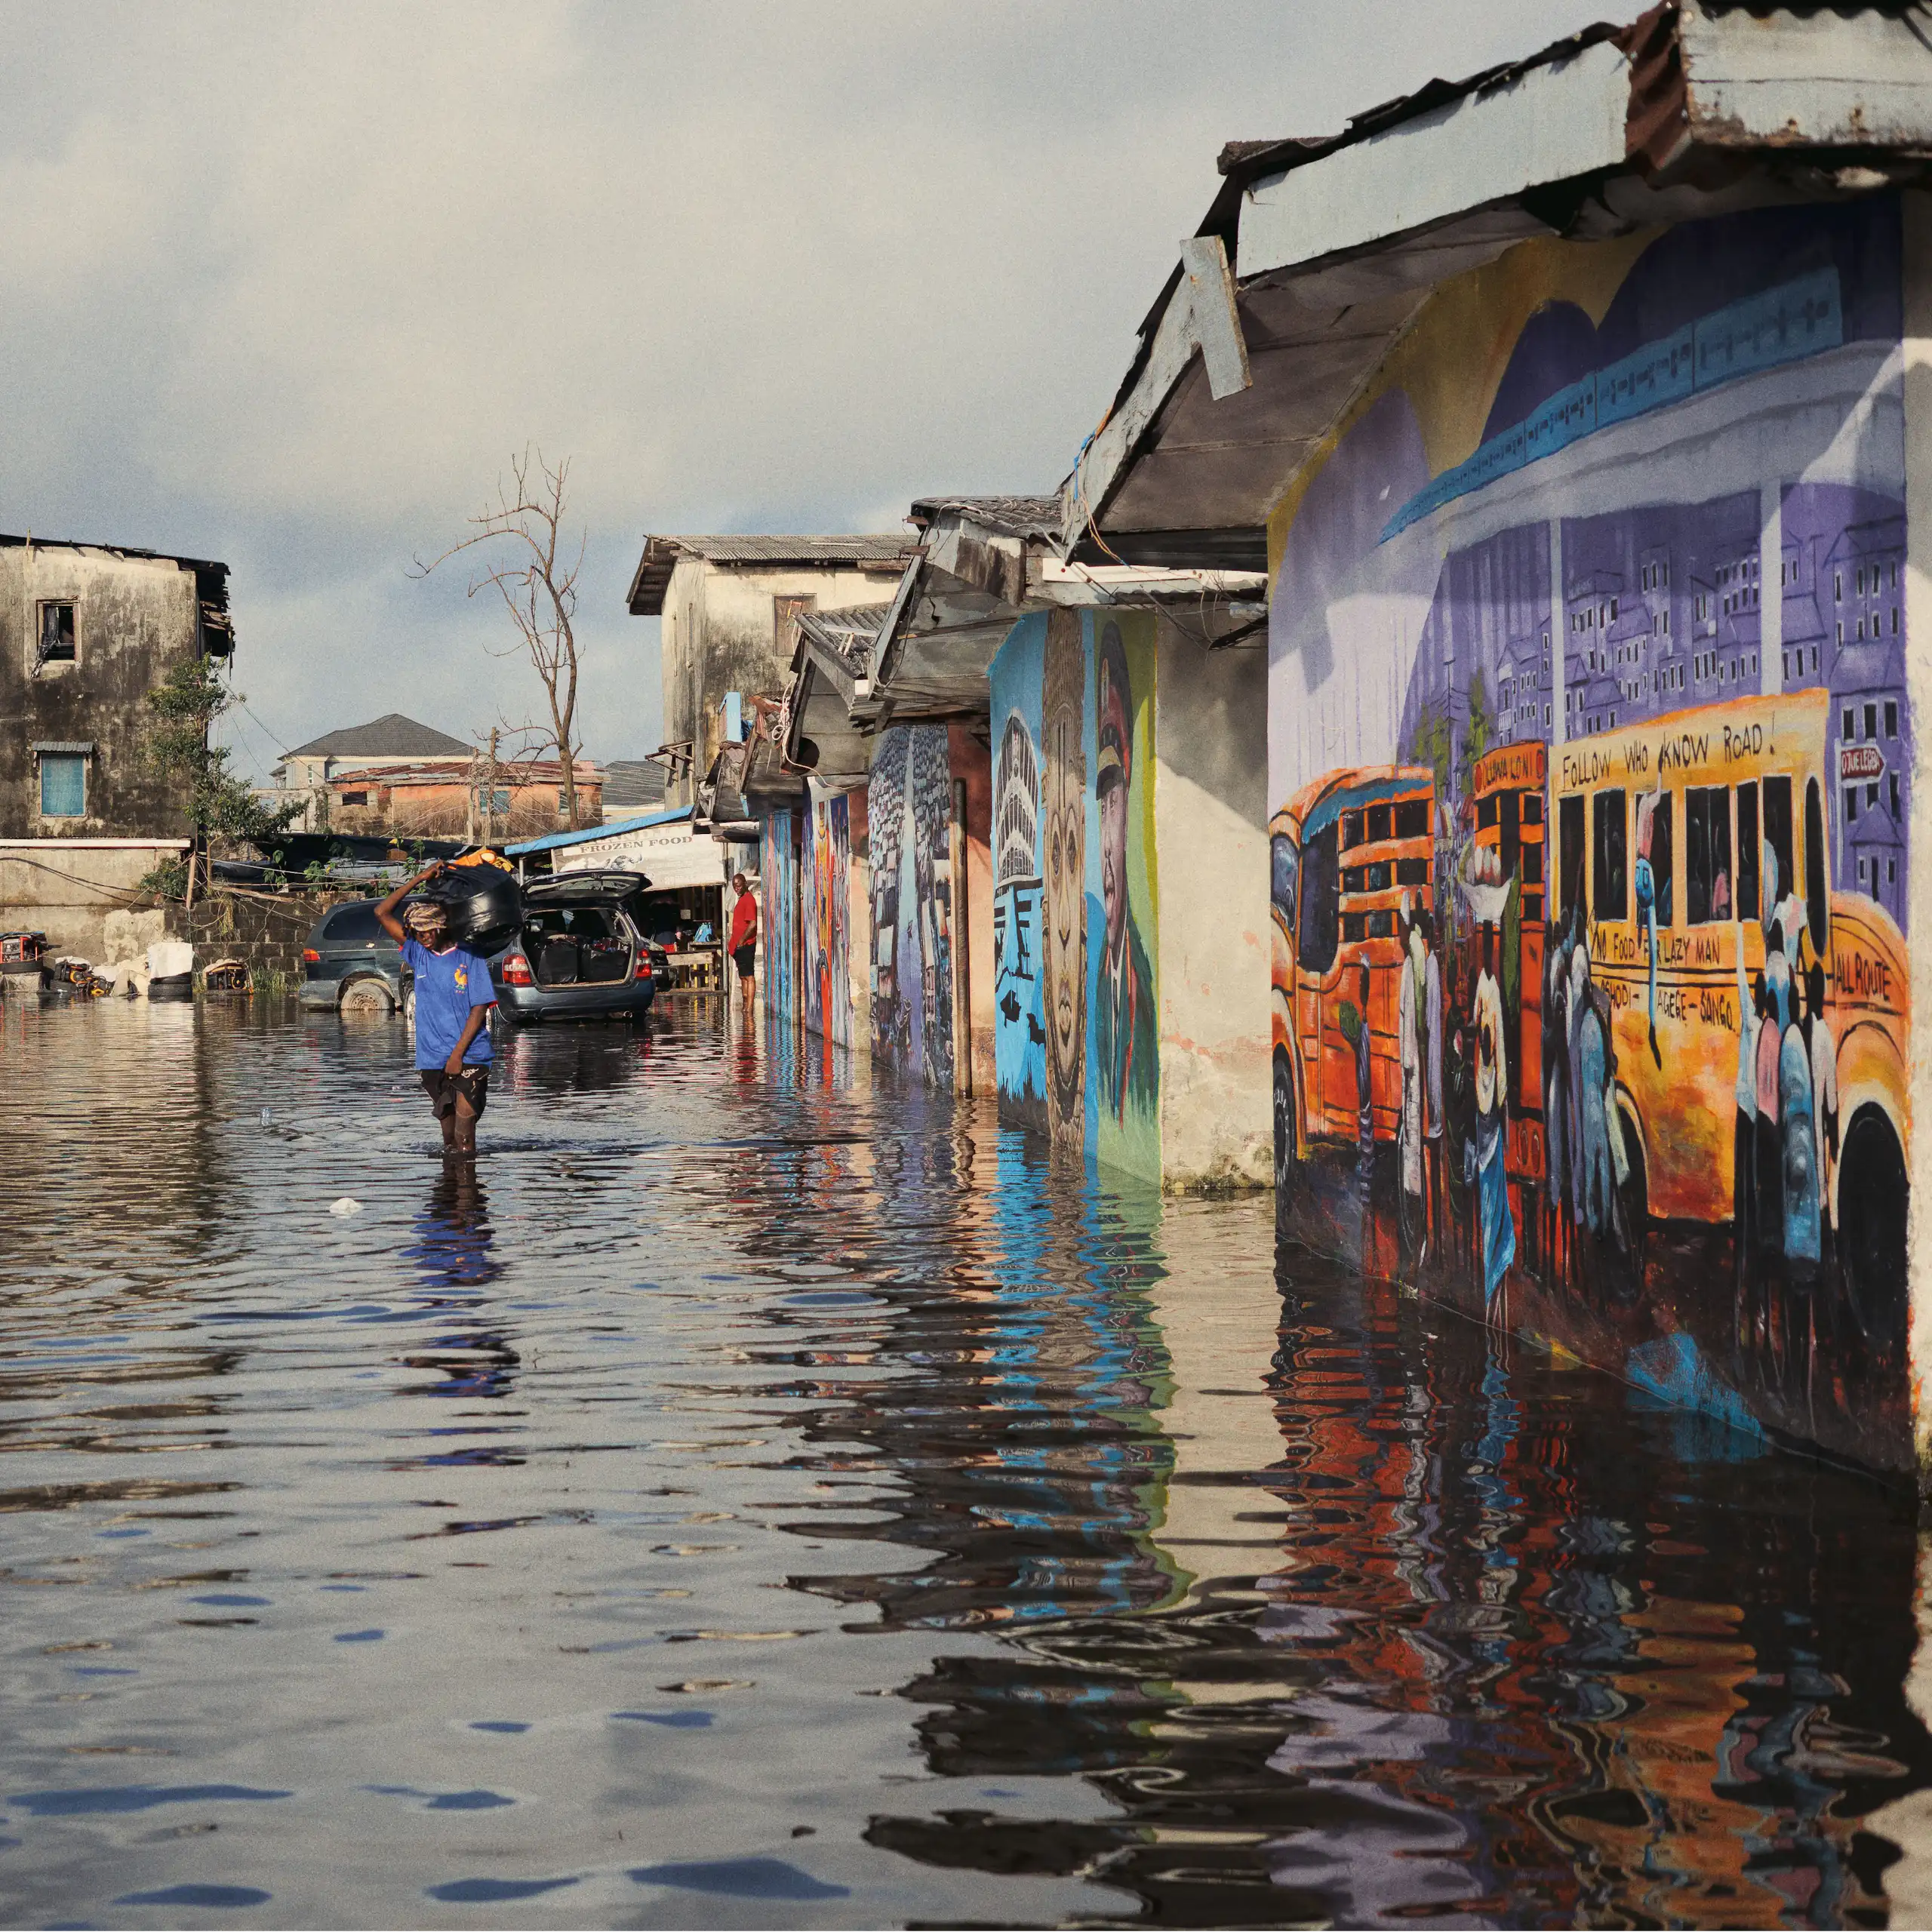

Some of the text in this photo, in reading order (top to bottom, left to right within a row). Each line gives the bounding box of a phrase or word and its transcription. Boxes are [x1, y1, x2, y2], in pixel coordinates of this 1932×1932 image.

[1510, 752, 1532, 780] LONI
[1623, 739, 1648, 776] WHO
[1663, 731, 1709, 769] KNOW
[580, 835, 693, 854] FROZEN FOOD
[1596, 929, 1720, 966] NO FOOD FR LAZY MAN
[1835, 951, 1890, 1001] ALL ROUTE
